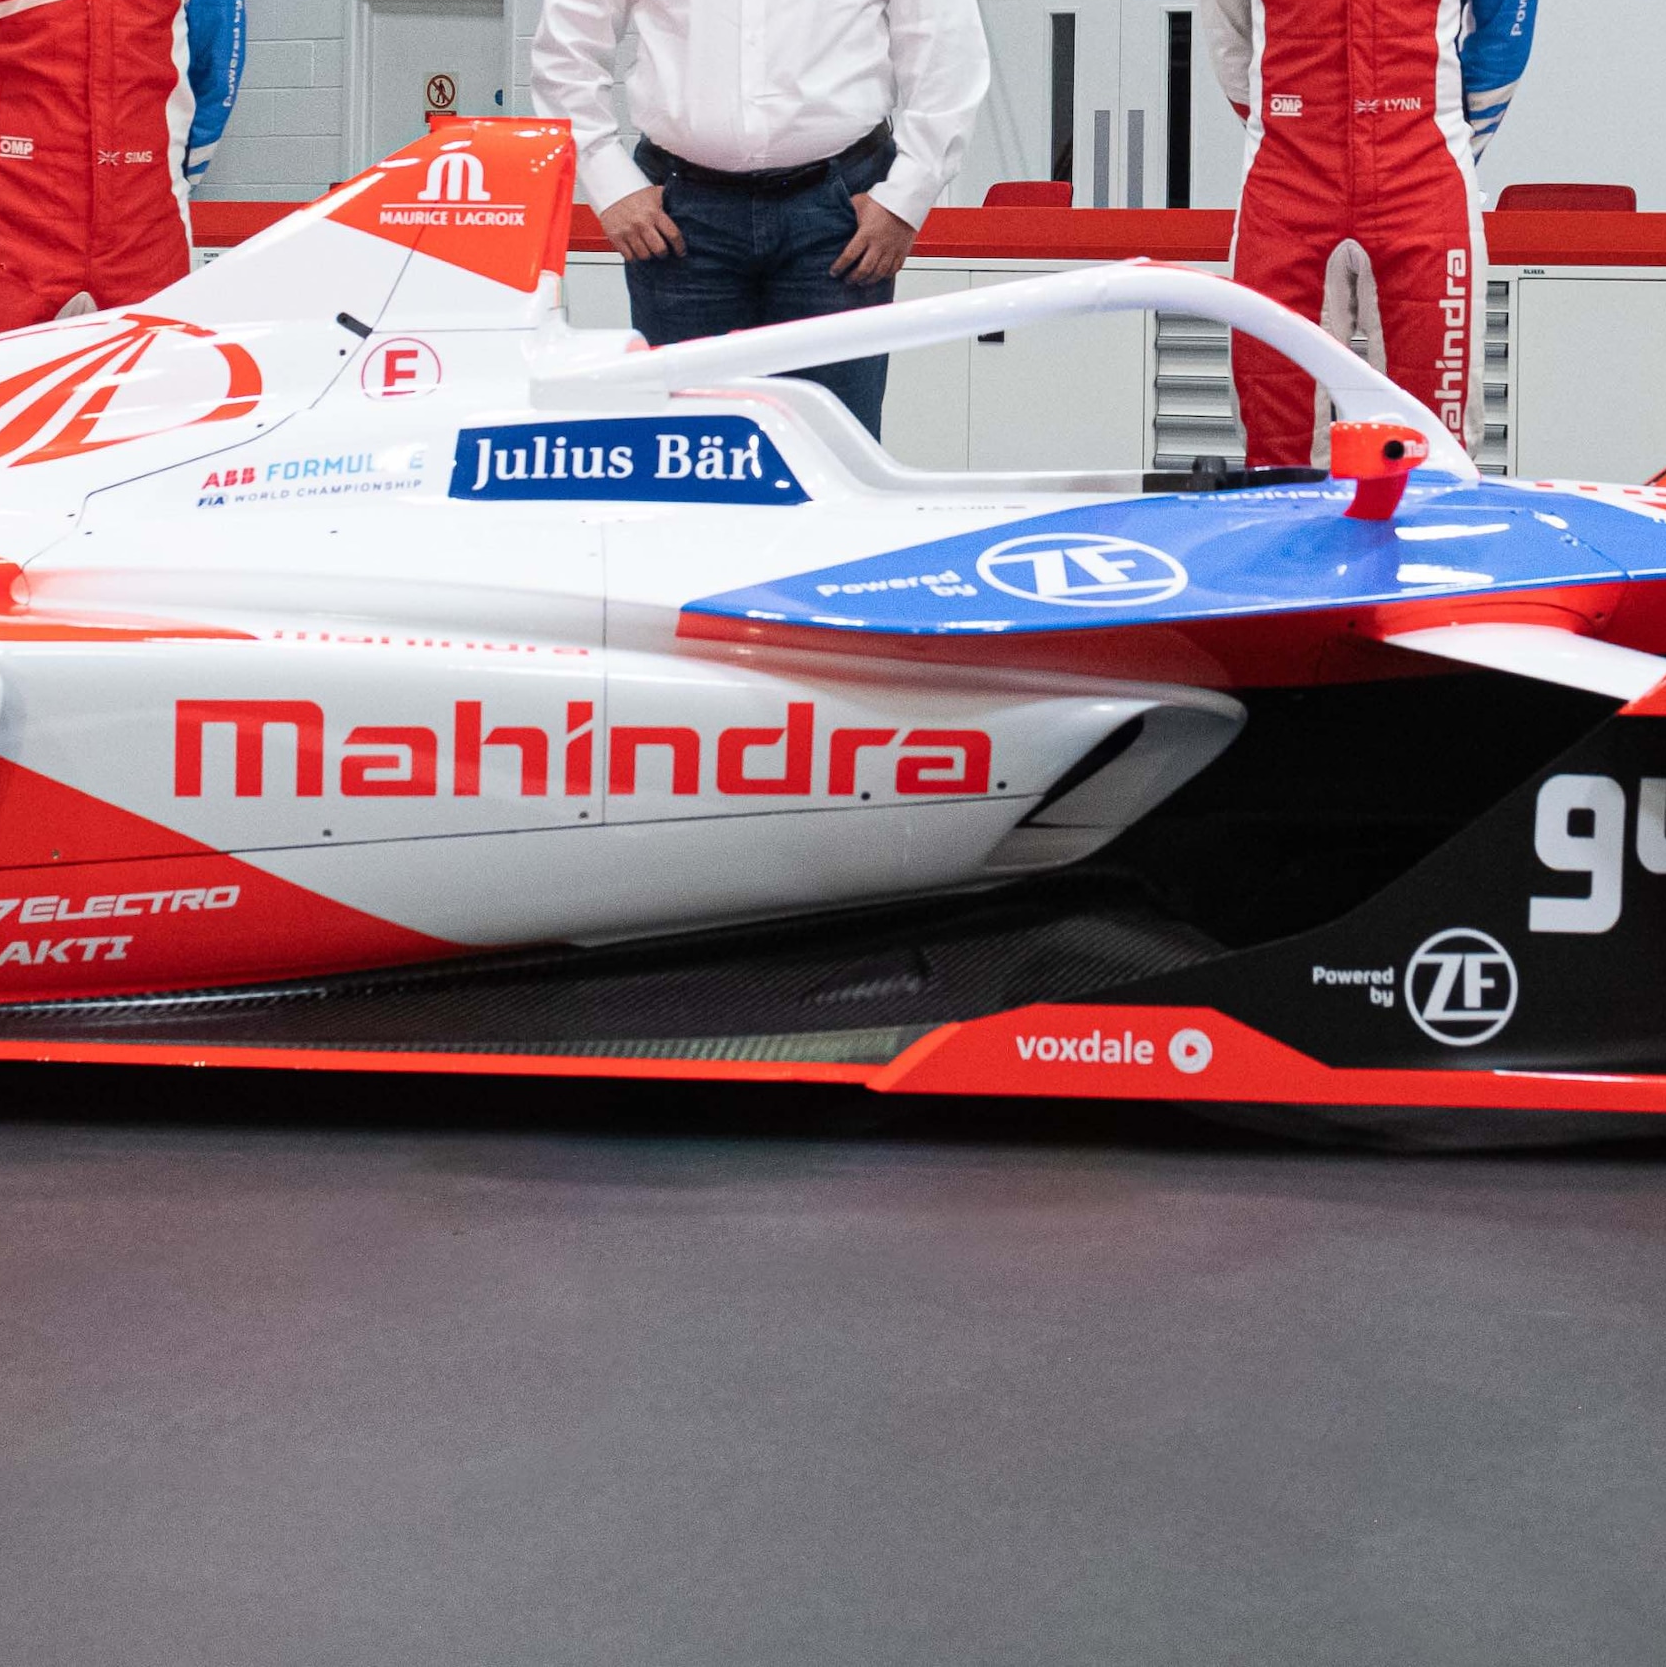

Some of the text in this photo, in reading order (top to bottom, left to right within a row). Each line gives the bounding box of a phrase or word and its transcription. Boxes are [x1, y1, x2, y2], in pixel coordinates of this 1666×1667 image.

[1270, 97, 1303, 113] OMP
[1384, 96, 1421, 112] LYNN
[0, 139, 33, 156] OMP
[124, 150, 152, 164] SIMS
[380, 209, 526, 226] MAURICE LACROIX
[1434, 249, 1467, 437] ahindra
[201, 467, 256, 490] ABB
[266, 452, 383, 482] FORMUL
[473, 436, 633, 490] Julius
[196, 478, 422, 507] FIA WORLD CHAMPIONSHIP
[817, 570, 962, 599] Powered
[983, 538, 1181, 603] ZF
[929, 581, 978, 600] by
[175, 700, 992, 796] Mahindra
[1312, 964, 1394, 986] Powered
[1408, 941, 1515, 1033] ZF
[1370, 986, 1394, 1008] by
[1016, 1032, 1154, 1065] voxdale
